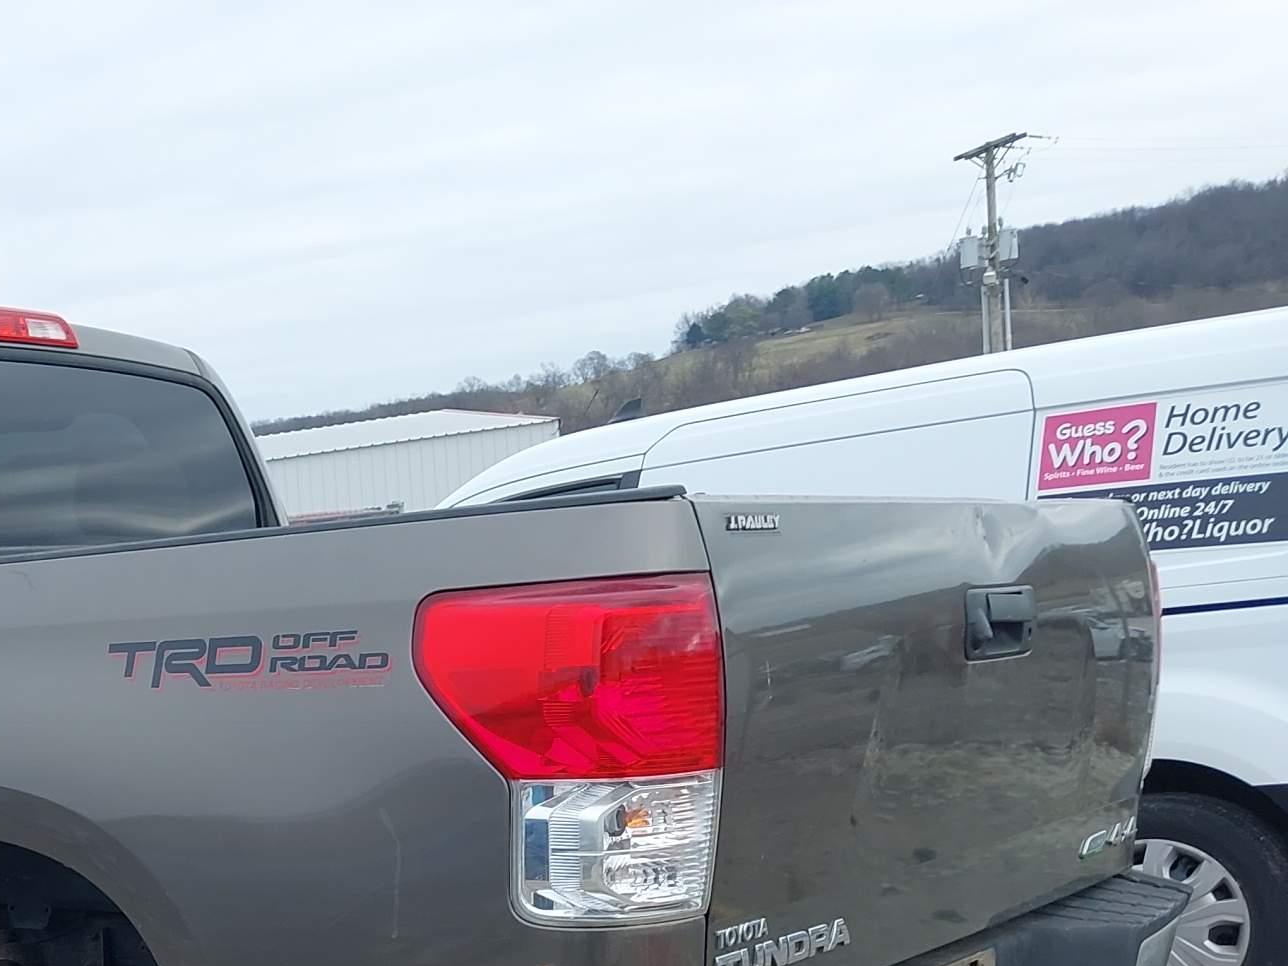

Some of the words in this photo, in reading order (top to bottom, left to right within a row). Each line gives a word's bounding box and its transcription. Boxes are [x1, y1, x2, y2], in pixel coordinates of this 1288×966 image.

[1165, 401, 1261, 429] Home
[1056, 421, 1115, 439] Guess
[1162, 424, 1288, 456] Delivery
[1048, 419, 1149, 468] Who?
[1043, 470, 1071, 481] Spirits
[1076, 467, 1096, 477] Fine
[1096, 465, 1118, 475] Wine
[1124, 462, 1146, 473] Beer
[1148, 488, 1180, 501] next
[1182, 485, 1210, 500] day
[1211, 480, 1272, 496] delivery
[1136, 504, 1192, 521] Online
[1192, 499, 1235, 517] 24/7
[271, 630, 359, 651] OFF
[108, 634, 262, 689] TRD
[268, 652, 389, 673] ROAD
[715, 917, 769, 949] TOYOTA
